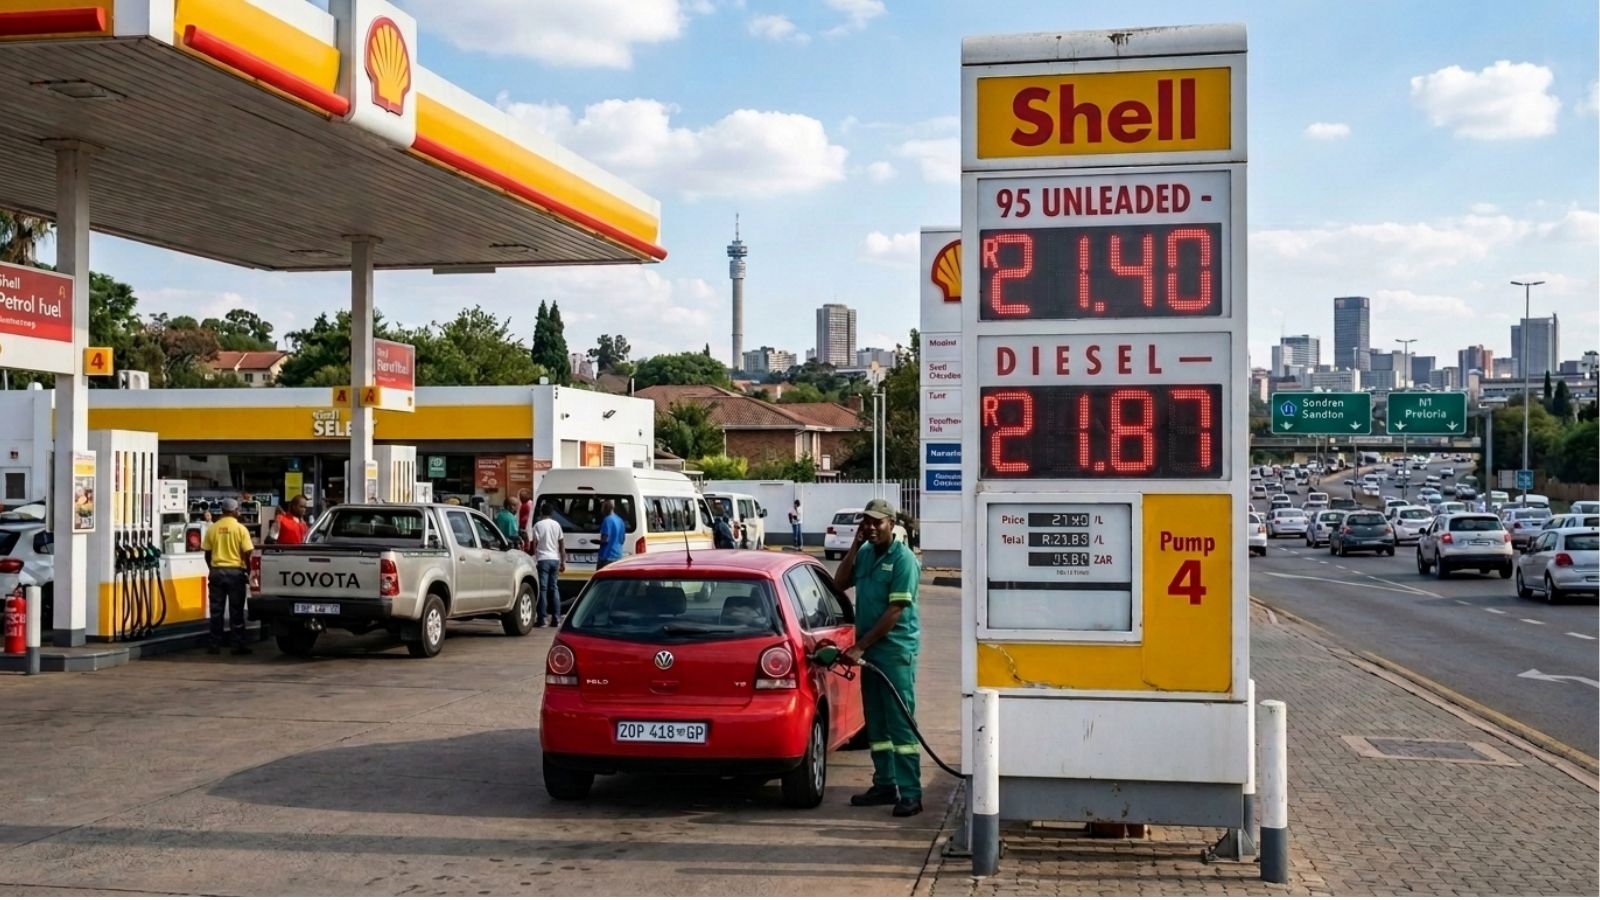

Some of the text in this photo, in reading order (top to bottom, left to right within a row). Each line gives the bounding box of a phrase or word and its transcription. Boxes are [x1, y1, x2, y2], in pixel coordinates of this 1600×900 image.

[1010, 78, 1196, 146] Shell
[996, 188, 1031, 218] 95
[1042, 184, 1191, 217] UNLEADED
[91, 352, 104, 370] 4
[997, 344, 1162, 376] DIESEL
[1419, 398, 1432, 406] N1
[1160, 531, 1216, 556] Pump
[1094, 555, 1113, 565] ZAR
[279, 571, 360, 589] TOYOTA
[1167, 559, 1207, 605] 4
[649, 724, 675, 739] 418
[687, 725, 704, 740] GP
